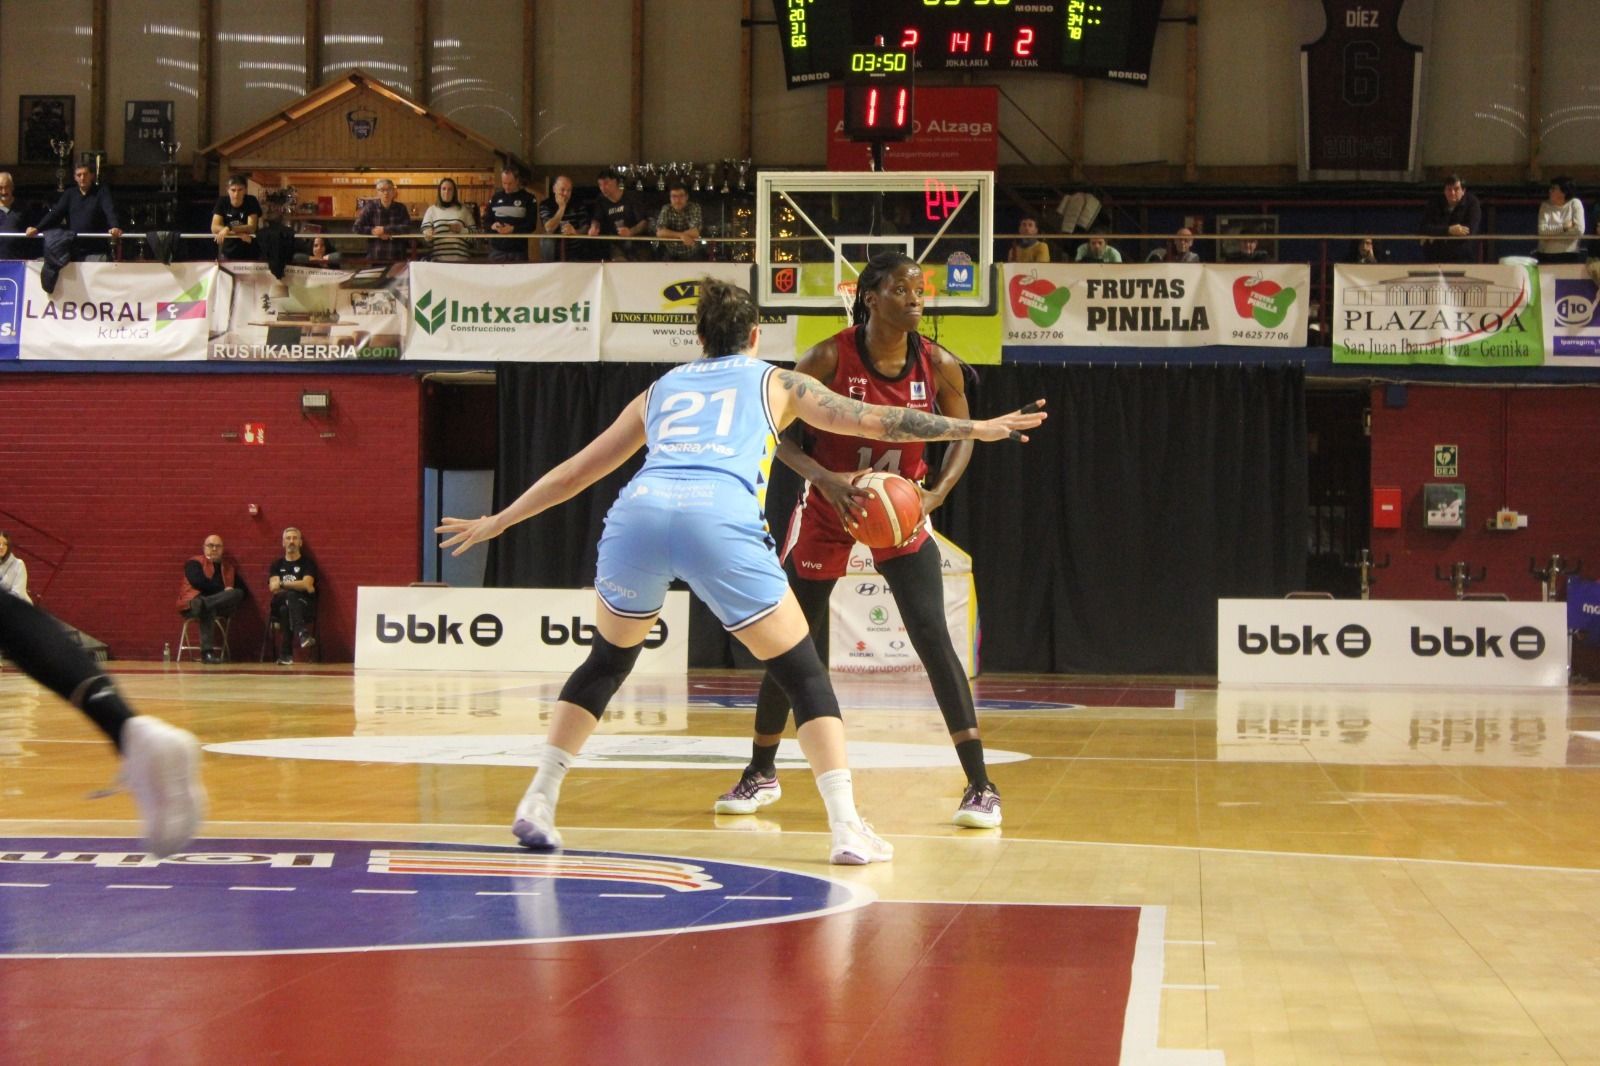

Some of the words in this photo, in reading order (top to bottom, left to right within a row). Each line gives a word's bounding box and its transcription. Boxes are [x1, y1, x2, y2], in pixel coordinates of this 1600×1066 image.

[1014, 5, 1054, 13] MONDO
[1068, 0, 1084, 13] 24
[789, 9, 805, 22] 20
[1067, 13, 1083, 27] 34
[1345, 6, 1379, 28] DÍEZ
[791, 22, 806, 35] 31
[1067, 26, 1082, 40] 78
[791, 35, 807, 48] 66
[951, 32, 970, 53] 14
[1015, 28, 1034, 56] 2
[851, 53, 907, 72] 03:50
[945, 58, 990, 68] JOKALARIA
[1010, 58, 1039, 68] FALTAK
[791, 71, 831, 83] MONDO
[1107, 69, 1148, 81] MONDO
[1342, 39, 1380, 107] 6
[927, 119, 993, 136] Alzaga
[1086, 278, 1186, 300] FRUTAS
[25, 299, 150, 322] LABORAL
[450, 300, 591, 324] Intxausti
[613, 313, 642, 323] VINOS
[1086, 306, 1210, 332] PINILLA
[1343, 309, 1527, 334] PLAZAKOA
[97, 325, 149, 340] kutxa
[450, 324, 516, 334] Construcciones
[1008, 330, 1019, 340] 94
[1020, 330, 1038, 340] 625
[1040, 330, 1051, 340] 77
[1052, 330, 1064, 340] 06
[1232, 330, 1244, 339] 94
[1245, 330, 1263, 340] 625
[1264, 331, 1276, 340] 77
[1277, 331, 1289, 341] 06
[213, 343, 398, 359] RUSTIKABERRIA.com
[1343, 338, 1369, 355] San
[1369, 338, 1397, 360] Juan
[1480, 340, 1530, 358] Gernika
[848, 376, 868, 385] vive
[657, 387, 738, 441] 21
[857, 446, 902, 476] 14
[1436, 467, 1456, 476] DEA
[801, 560, 823, 570] vive
[376, 613, 464, 645] bbk
[540, 615, 598, 647] bb
[1237, 624, 1331, 656] bbk
[1410, 625, 1505, 658] bbk
[836, 664, 924, 675] www.grupoorta
